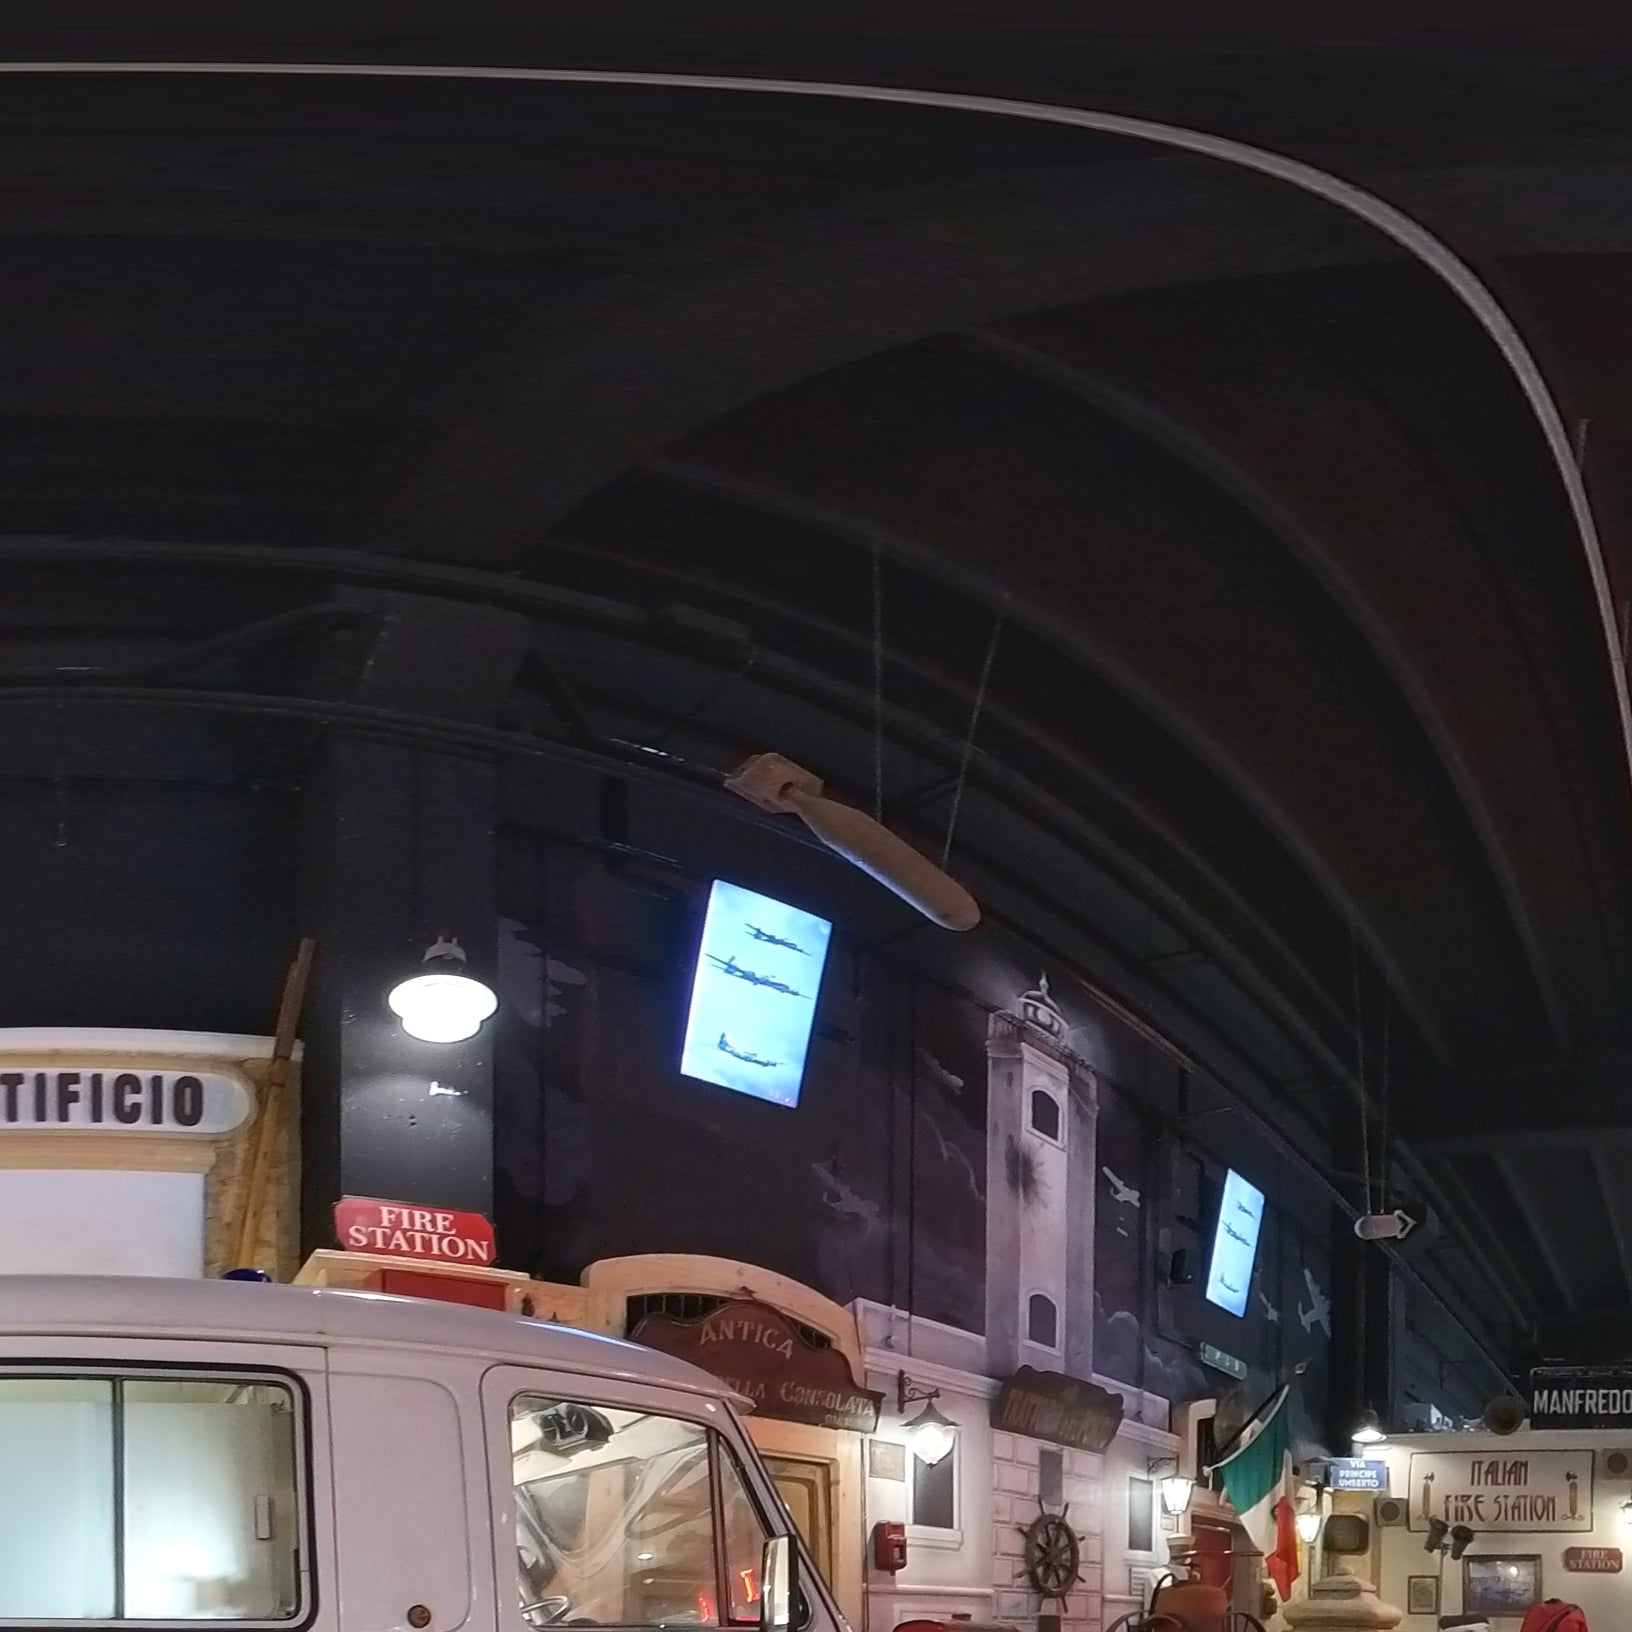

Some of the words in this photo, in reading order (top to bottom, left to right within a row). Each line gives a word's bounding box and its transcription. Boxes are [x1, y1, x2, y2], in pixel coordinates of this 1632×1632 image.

[379, 1206, 456, 1234] FIRE
[348, 1225, 489, 1261] STATION
[700, 1319, 794, 1360] ANTICA
[723, 1375, 766, 1399] ELLA
[1339, 1470, 1377, 1478] PRINCIPE
[1350, 1459, 1366, 1468] VIA
[1470, 1460, 1528, 1486] ITALIAN
[1338, 1479, 1379, 1487] UMBERTO
[1444, 1494, 1487, 1522] FIRE
[1494, 1494, 1556, 1522] STATION
[1569, 1559, 1620, 1570] STATION
[1580, 1549, 1608, 1560] FIRE
